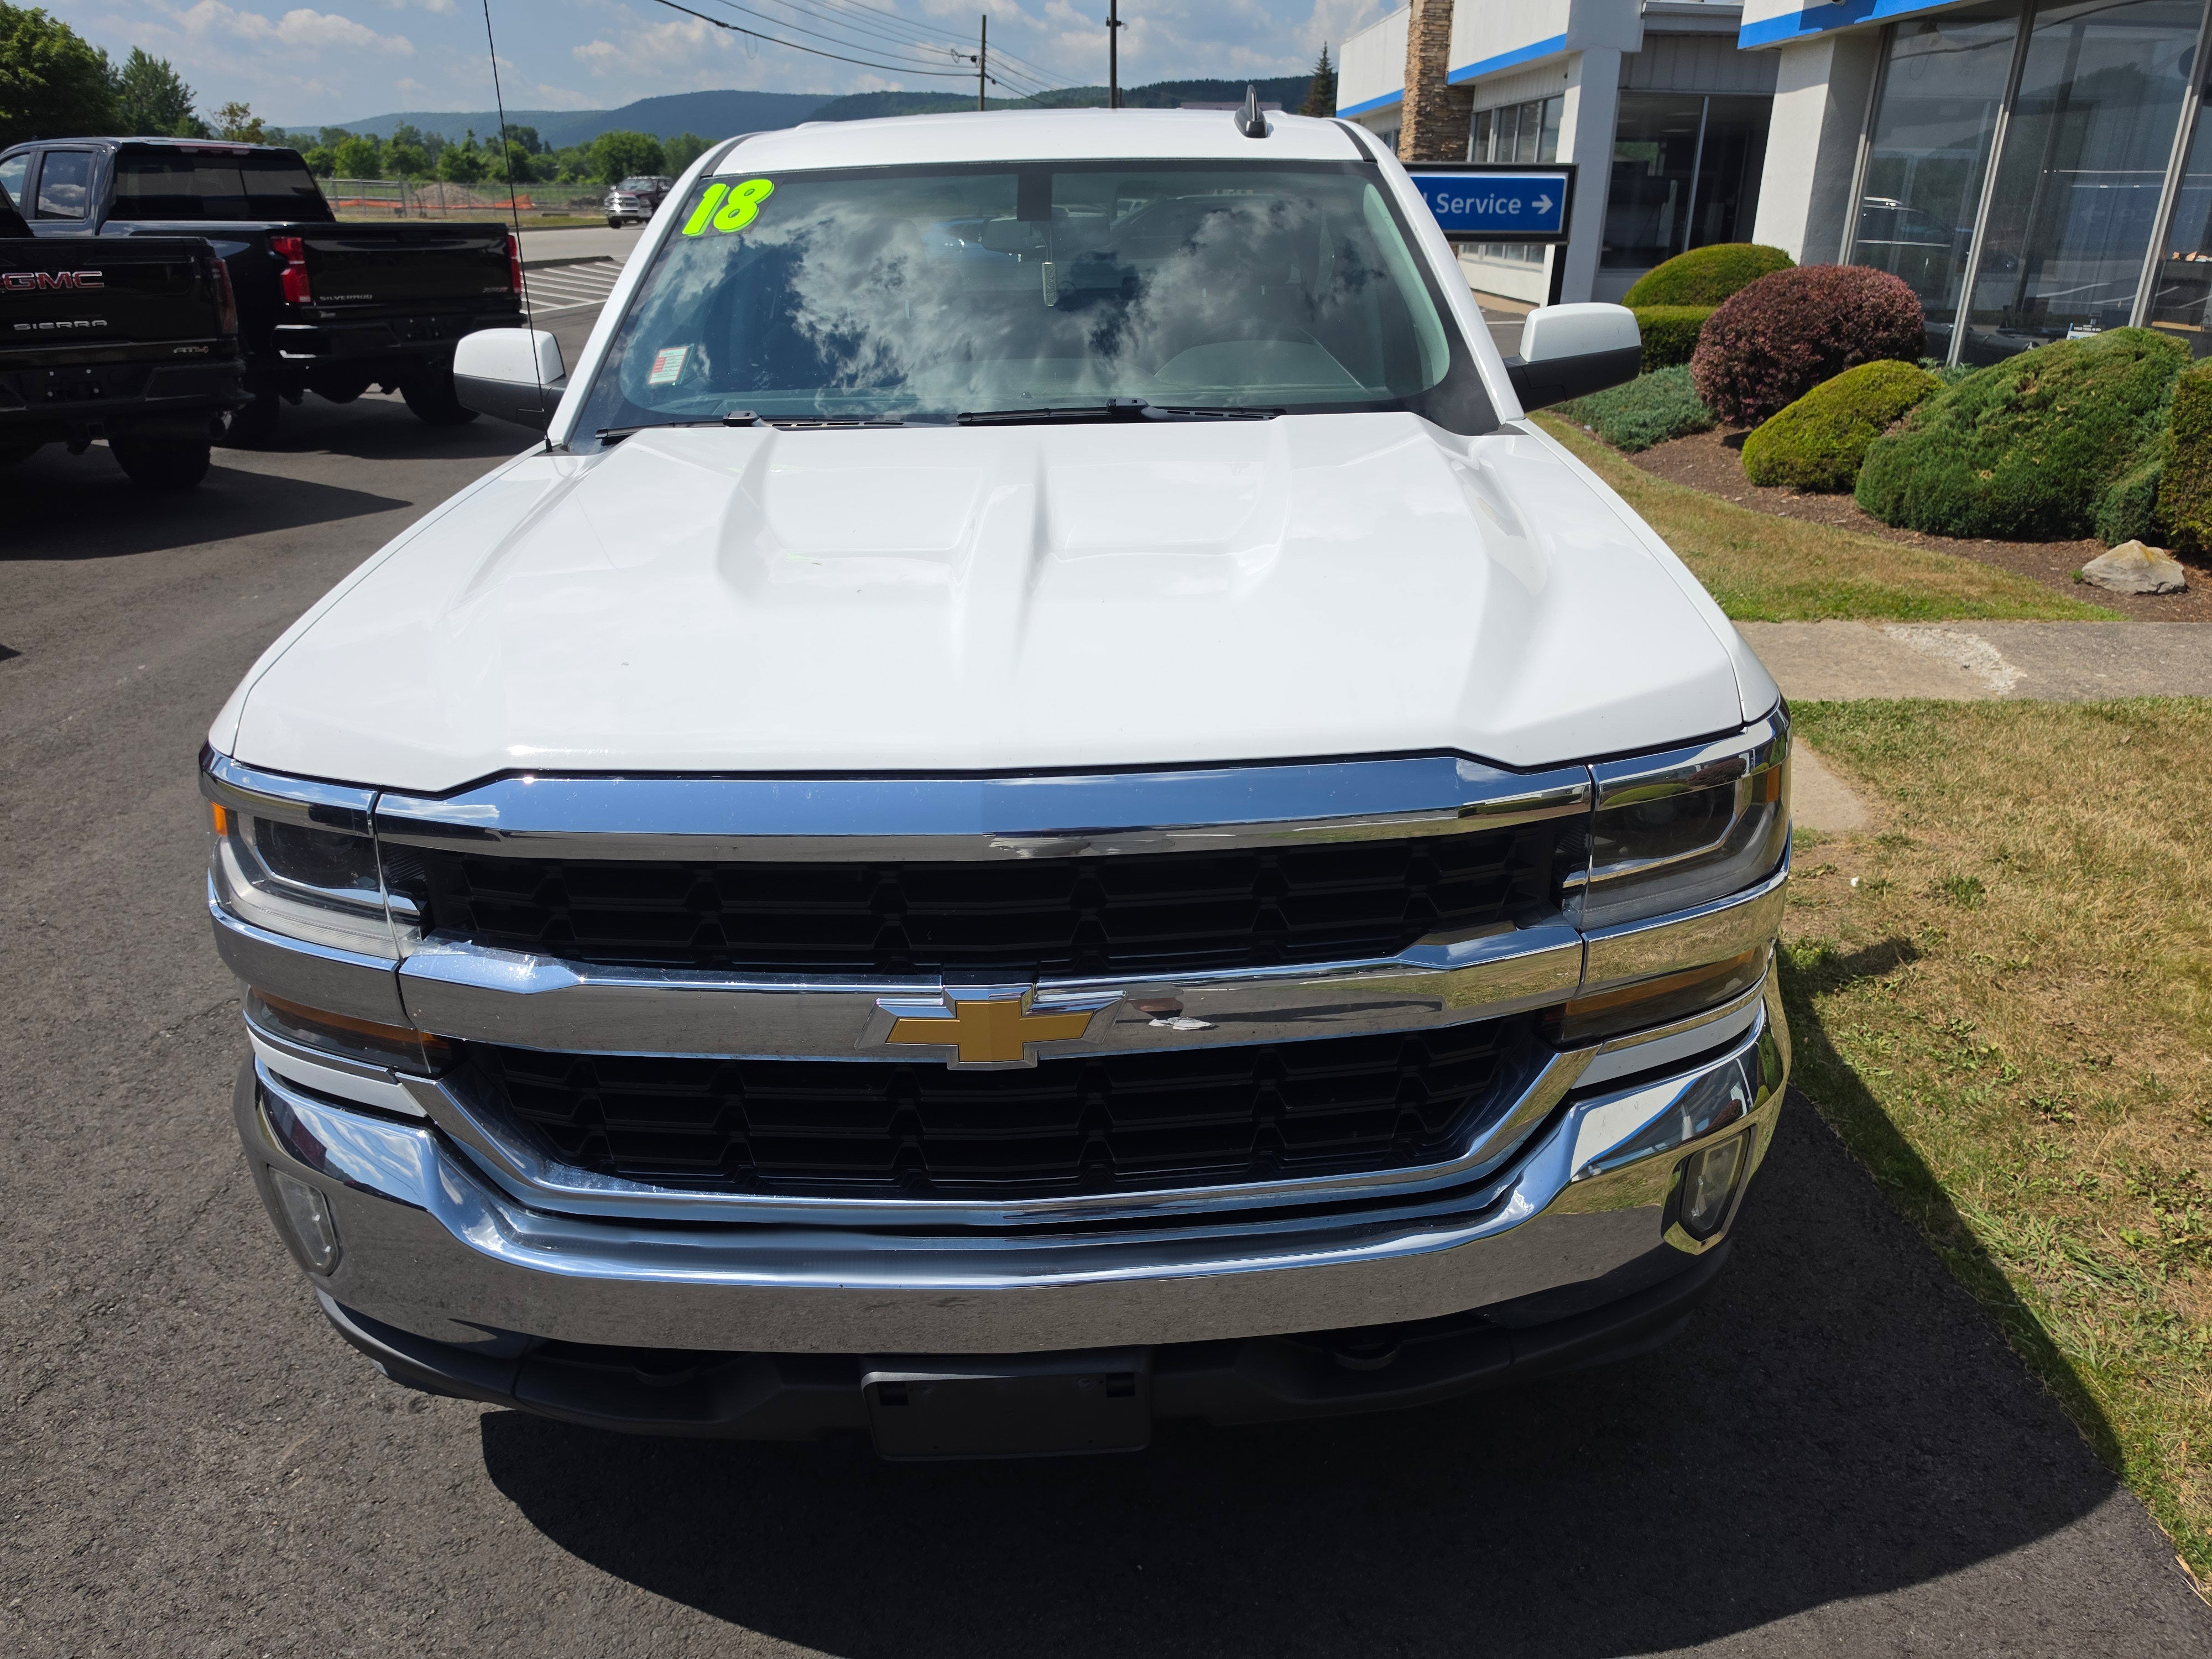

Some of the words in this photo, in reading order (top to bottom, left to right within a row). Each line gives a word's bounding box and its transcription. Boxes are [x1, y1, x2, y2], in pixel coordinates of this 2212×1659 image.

[682, 179, 775, 237] 18
[1436, 192, 1521, 215] Service
[2, 270, 105, 290] GMC
[13, 320, 108, 331] SIERRA
